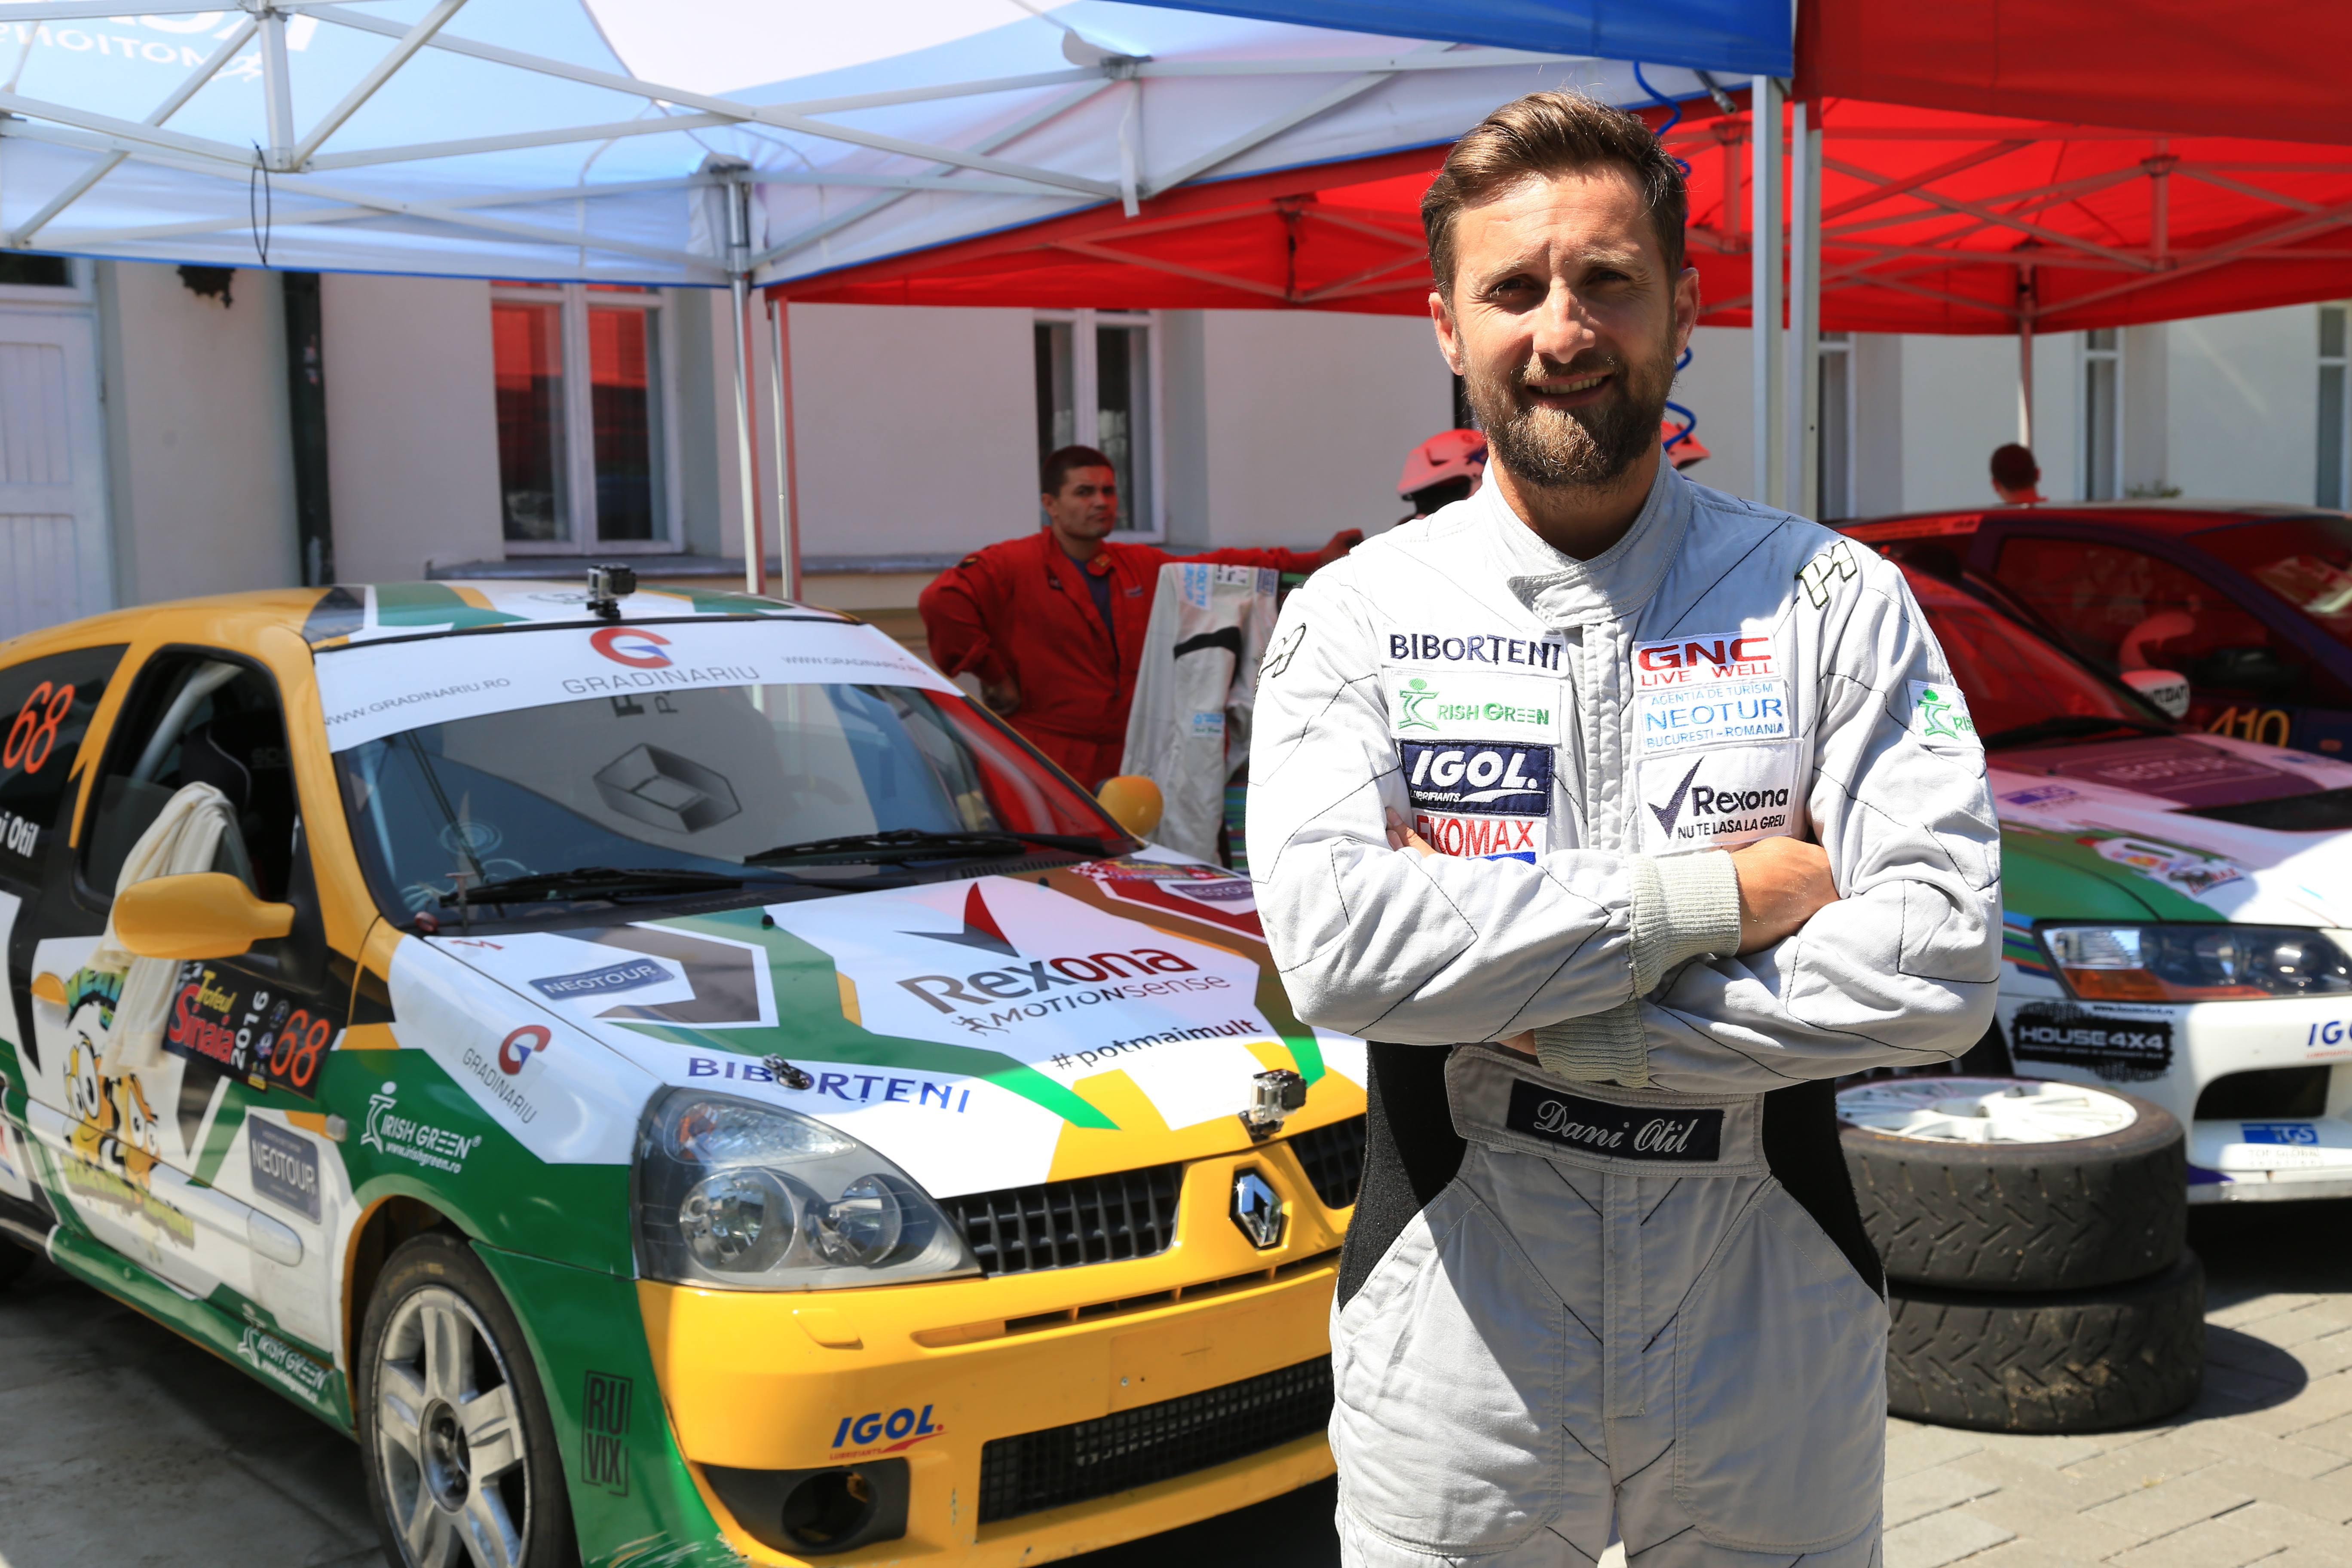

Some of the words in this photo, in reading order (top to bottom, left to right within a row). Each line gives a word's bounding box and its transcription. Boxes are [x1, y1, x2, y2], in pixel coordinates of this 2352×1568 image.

[1638, 637, 1771, 671] GNC
[563, 665, 760, 695] GRADINARIU
[1641, 670, 1692, 686] LIVE
[1712, 663, 1774, 678] WELL
[1708, 688, 1724, 698] DE
[1727, 683, 1773, 695] TURISM
[3, 680, 75, 774] 68
[1482, 702, 1550, 725] GREEN
[1645, 698, 1782, 732] NEOTUR
[1646, 729, 1714, 748] BUCURESTI
[1725, 723, 1784, 737] ROMANIA
[1692, 785, 1789, 817] Rexona
[1678, 825, 1694, 839] NU
[1696, 823, 1710, 836] TE
[1744, 819, 1758, 832] LA
[1760, 814, 1786, 829] GREU
[194, 969, 238, 1013] Trofeul
[542, 965, 658, 994] NEOTOUR
[895, 948, 1199, 1015] Rexona
[168, 983, 236, 1064] Sinaia
[231, 990, 270, 1070] 2016
[2019, 1025, 2107, 1047] HOUSE
[2308, 1020, 2352, 1046] IG
[270, 1008, 331, 1087] 68
[1050, 1018, 1262, 1070] #potmaimult
[462, 1047, 538, 1125] GRADINARIU
[1533, 1099, 1630, 1148] Dani
[1634, 1118, 1699, 1153] Otil
[252, 1139, 316, 1195] NEOTOUR
[589, 1376, 626, 1436] RU
[586, 1433, 622, 1487] VIX
